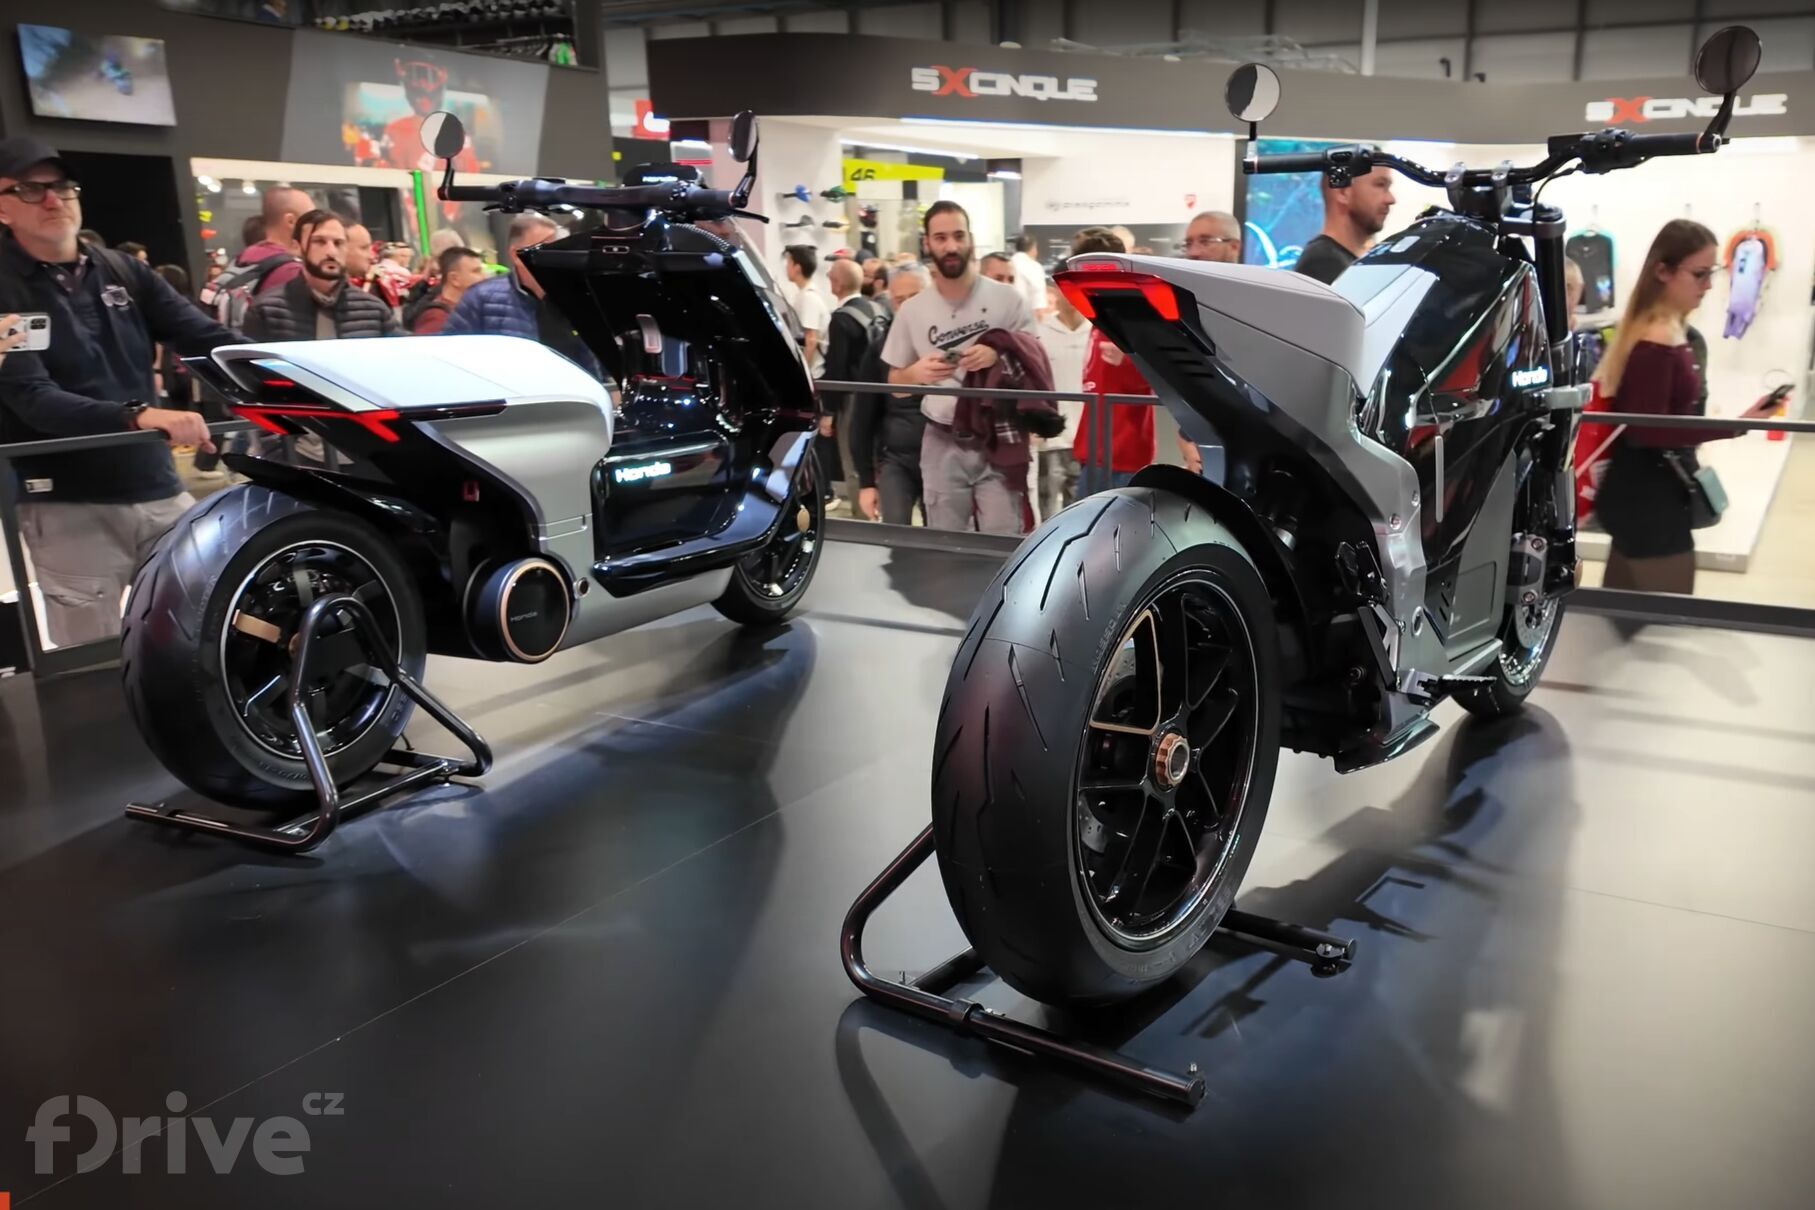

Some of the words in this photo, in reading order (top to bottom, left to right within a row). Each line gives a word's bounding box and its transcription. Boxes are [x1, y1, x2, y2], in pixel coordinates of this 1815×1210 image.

[928, 320, 989, 345] Converse
[1512, 365, 1548, 387] Honda
[615, 461, 671, 483] Honda
